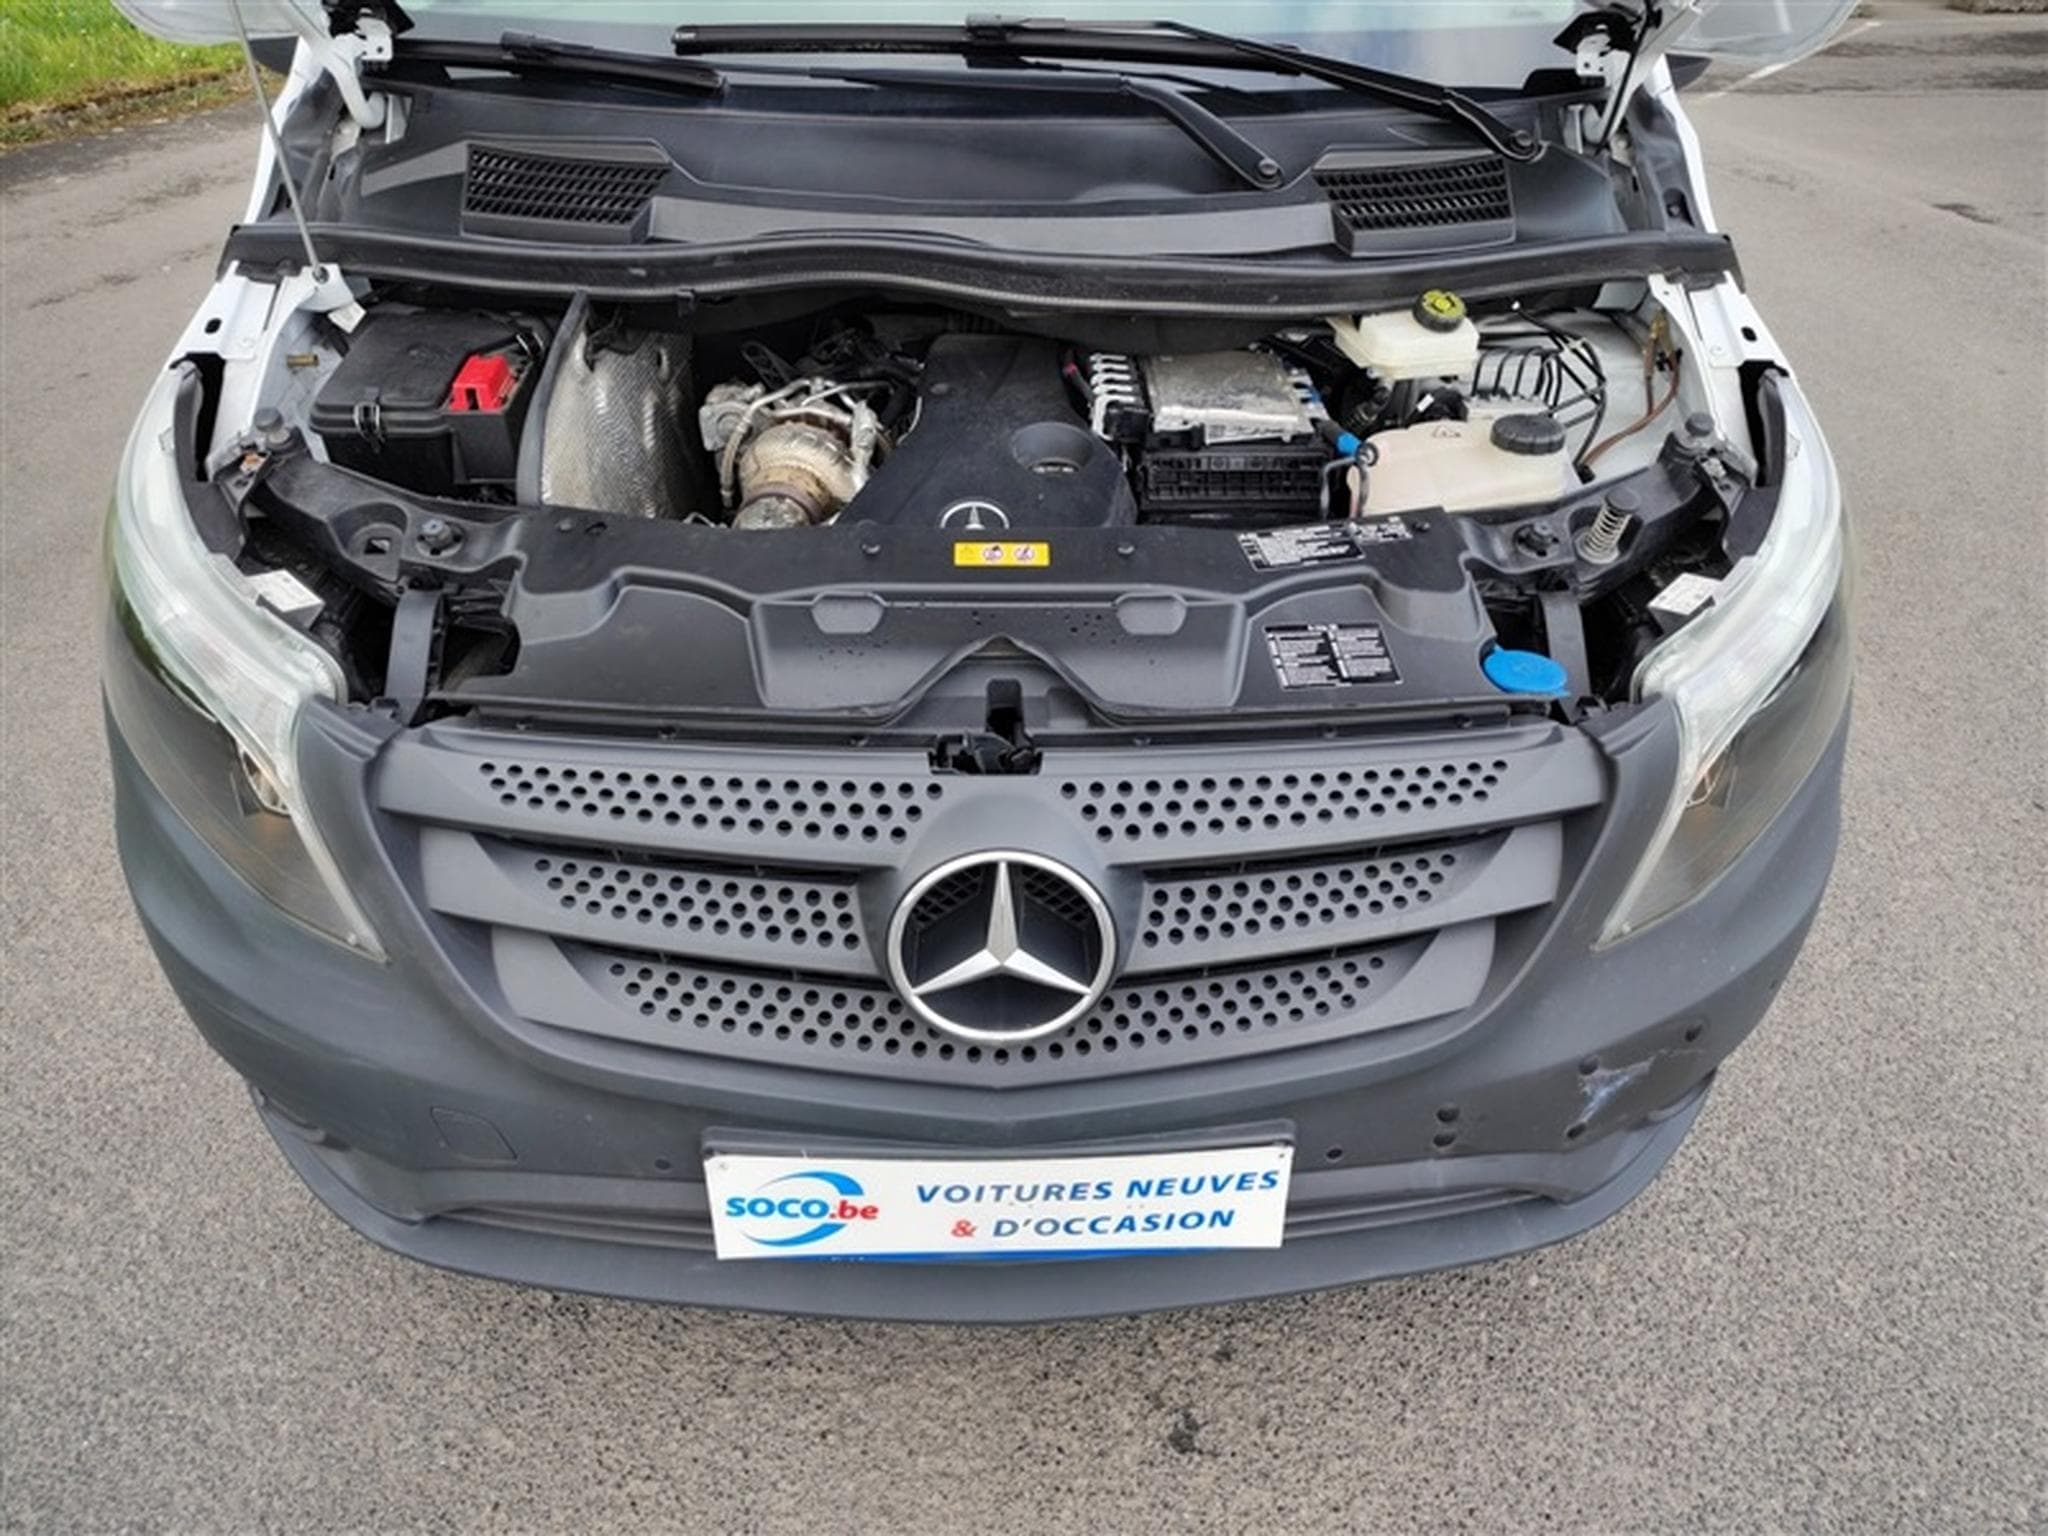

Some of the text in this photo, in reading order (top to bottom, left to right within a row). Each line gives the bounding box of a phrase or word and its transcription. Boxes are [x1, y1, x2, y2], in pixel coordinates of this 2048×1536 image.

[917, 1169, 1280, 1204] VOITURES NEUVES
[726, 1196, 879, 1221] SOCO.be
[951, 1208, 1235, 1239] & D'OCCASION
